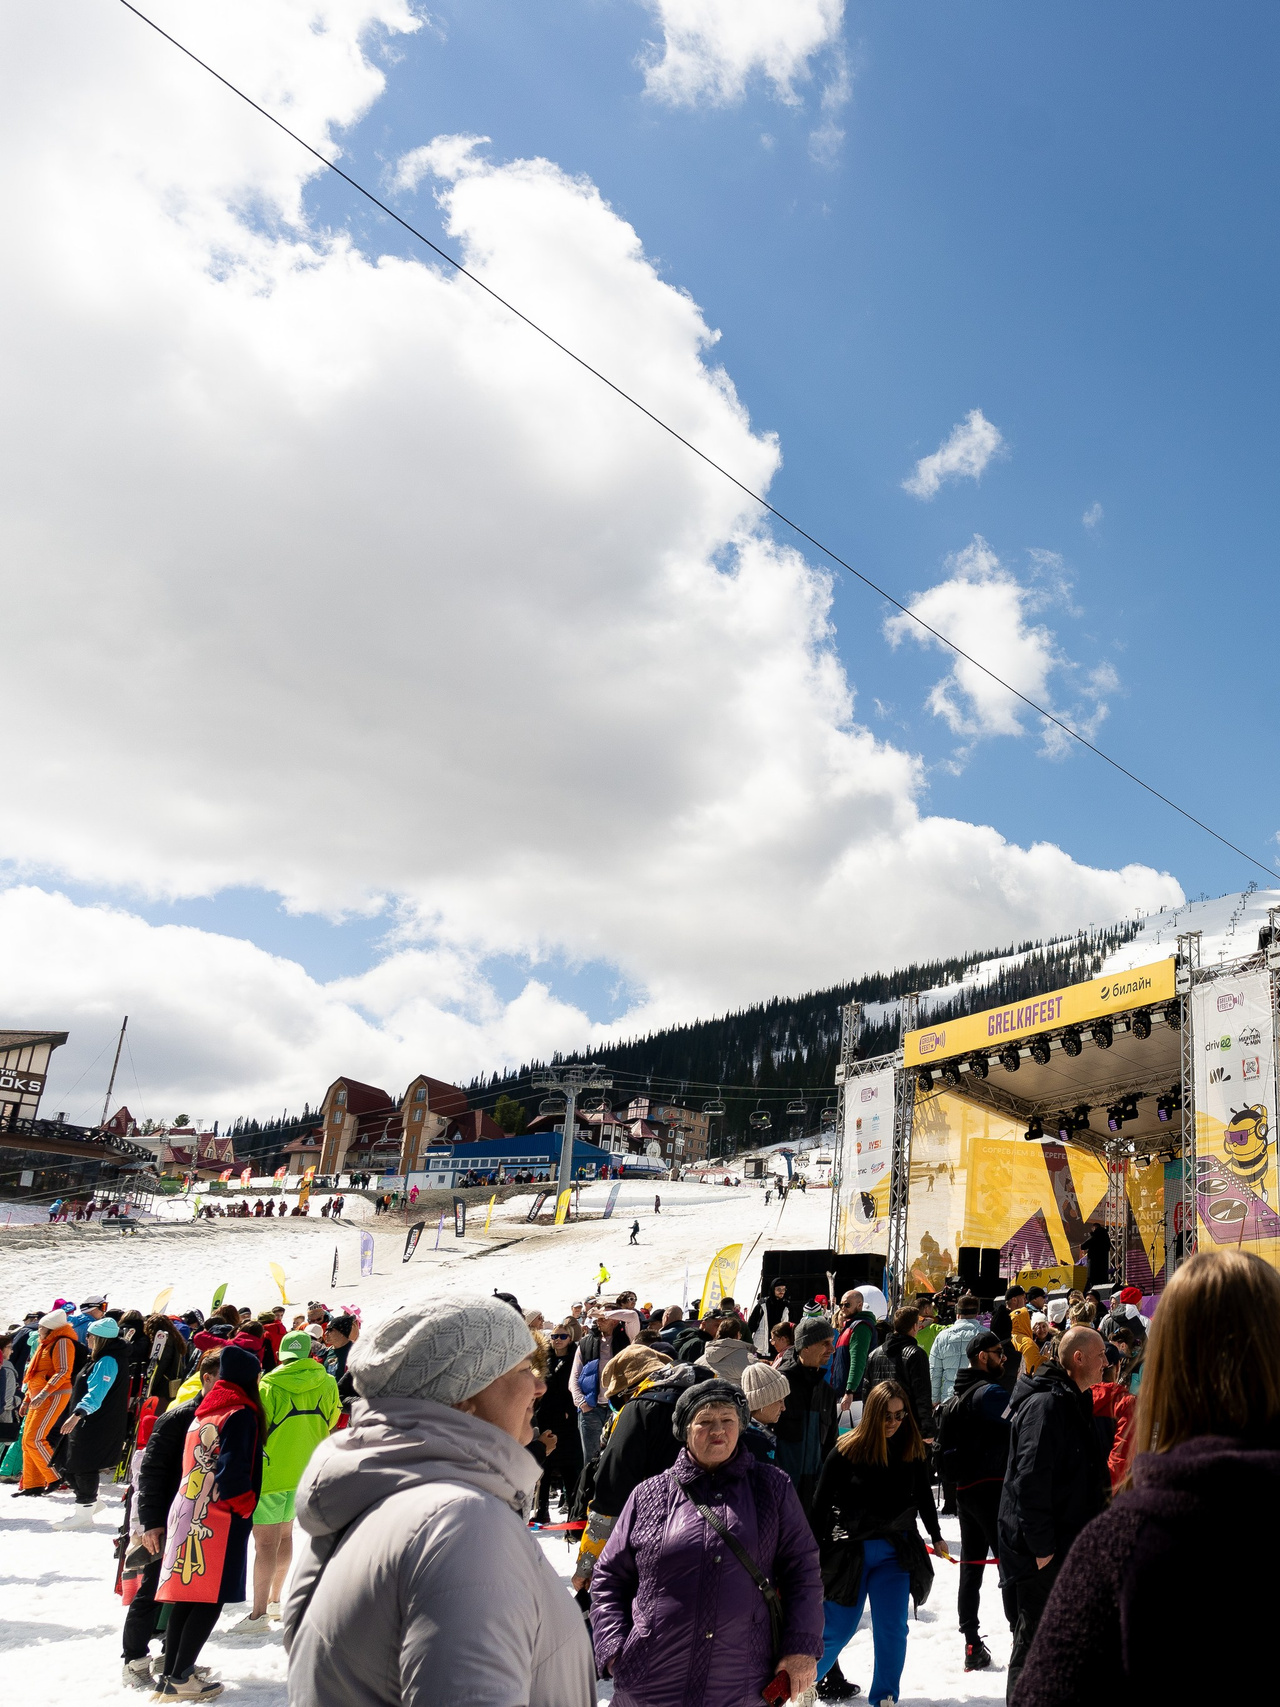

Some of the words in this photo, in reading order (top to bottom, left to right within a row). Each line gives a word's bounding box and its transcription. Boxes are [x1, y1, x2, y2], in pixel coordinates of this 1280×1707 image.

[1113, 978, 1152, 997] билайн
[988, 997, 1063, 1037] GRELKAFEST
[1, 1069, 18, 1077] THE
